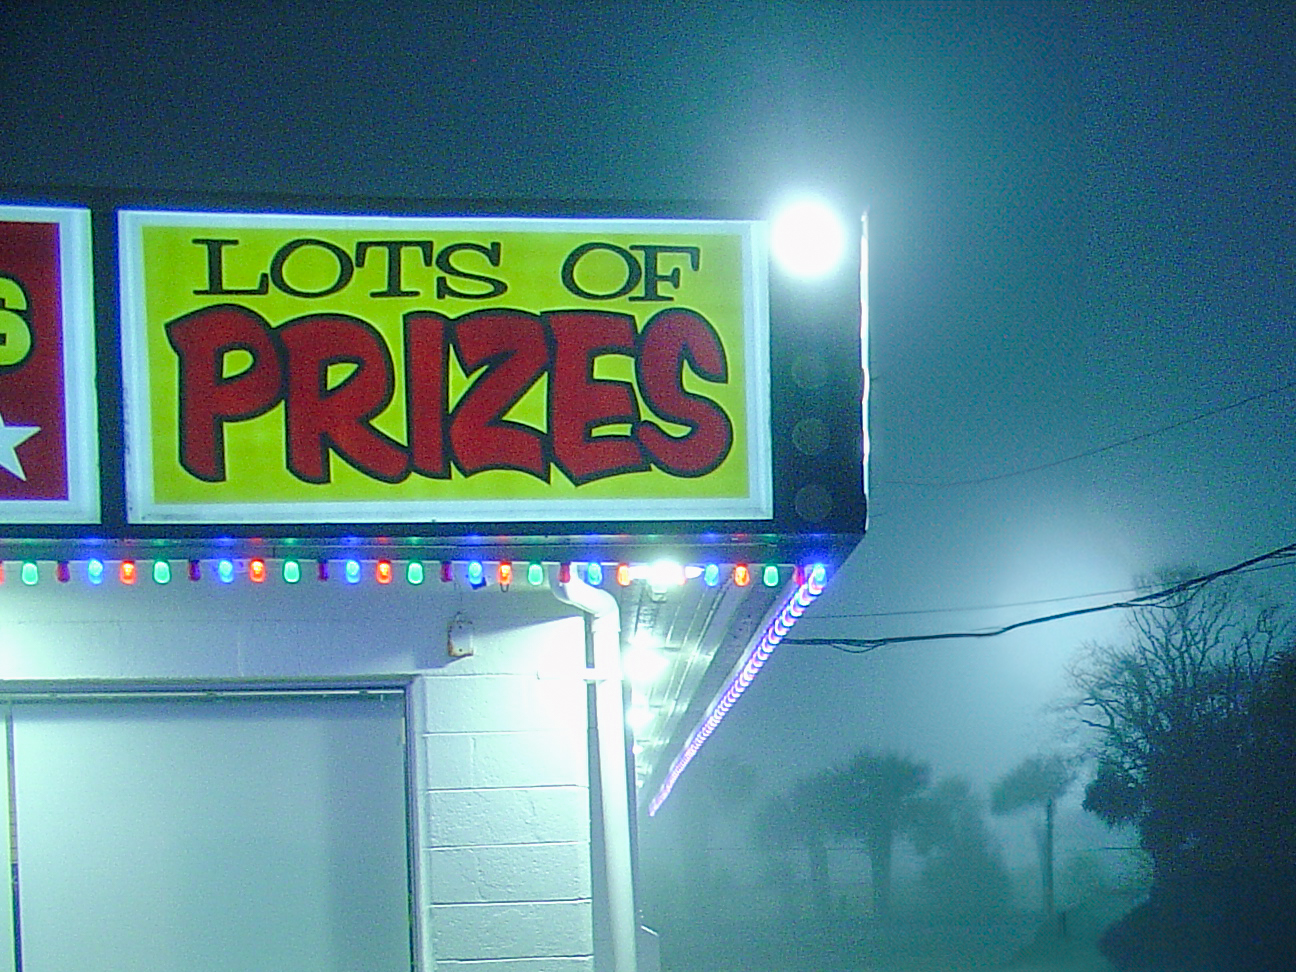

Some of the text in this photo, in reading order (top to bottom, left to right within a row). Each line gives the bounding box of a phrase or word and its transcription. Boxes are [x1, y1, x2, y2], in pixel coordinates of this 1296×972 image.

[191, 237, 701, 302] LOTS OF
[164, 303, 734, 487] PRIZES
